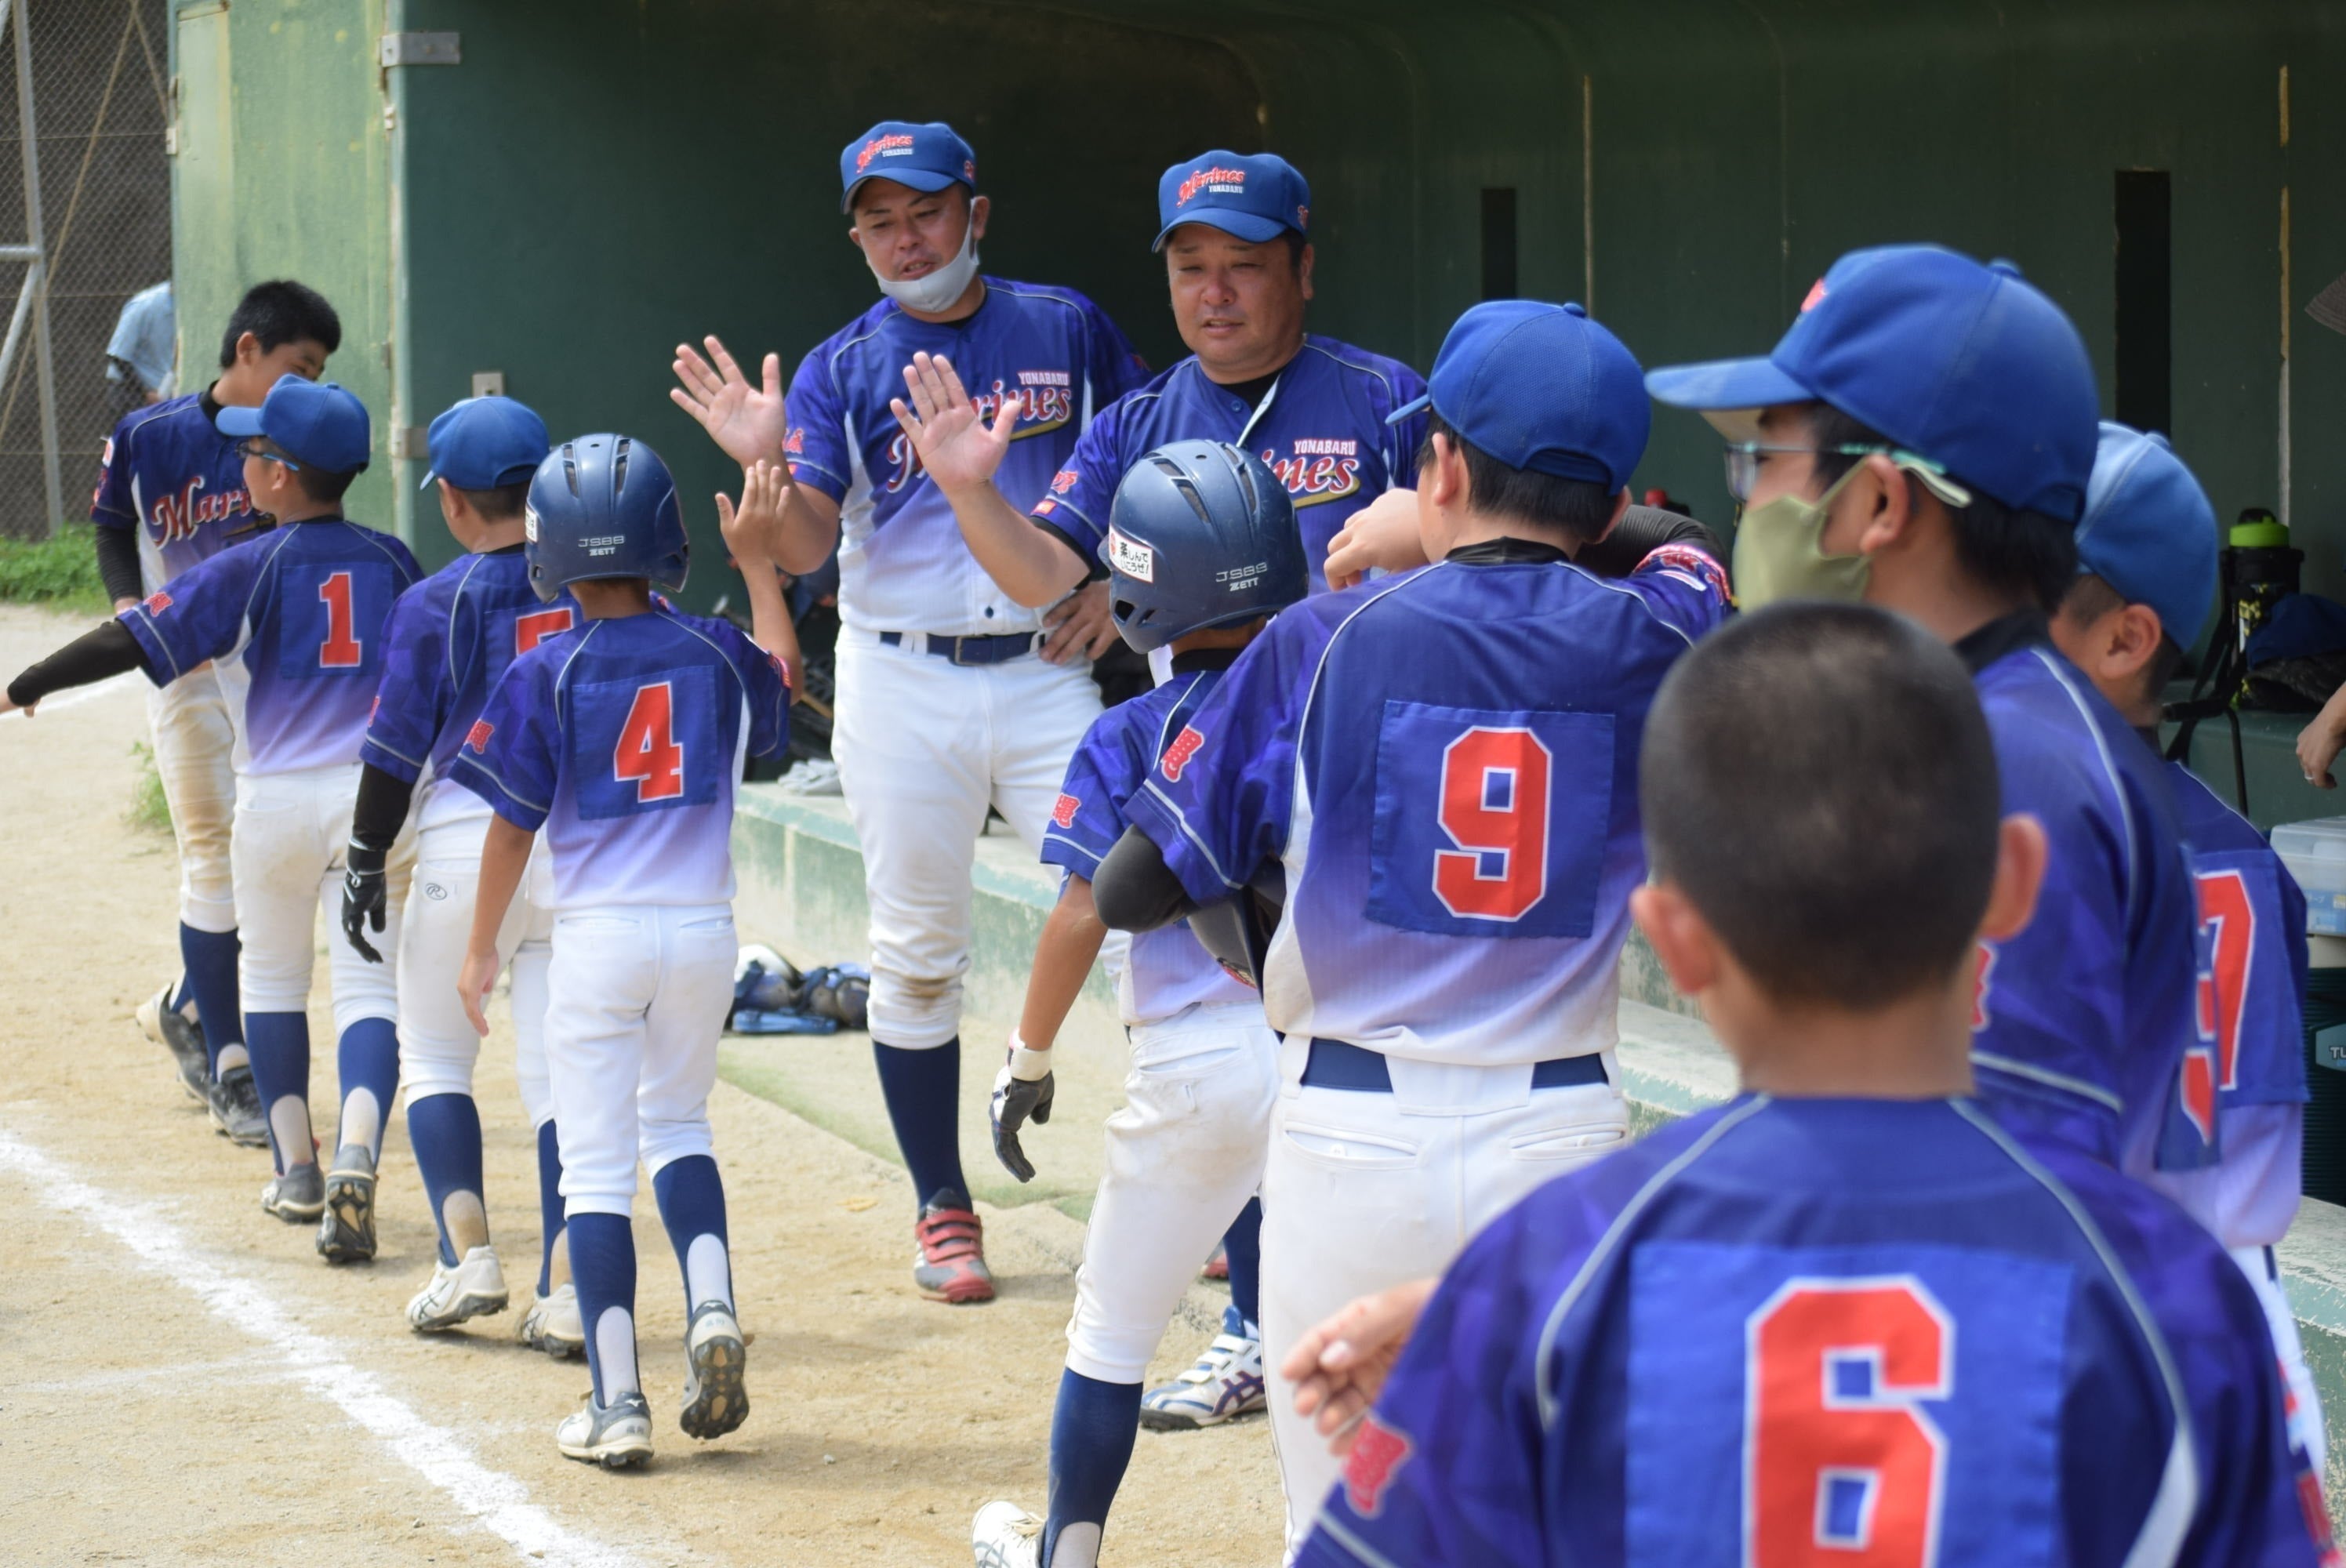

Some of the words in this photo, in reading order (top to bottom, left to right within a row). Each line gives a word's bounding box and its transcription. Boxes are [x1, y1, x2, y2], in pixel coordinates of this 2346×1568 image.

[1177, 167, 1245, 208] Marines
[1018, 372, 1069, 386] YONABARU
[1294, 439, 1356, 455] YONABARU
[151, 475, 252, 550] Mari
[589, 547, 616, 556] ZETT
[1229, 577, 1259, 591] ZETT
[319, 572, 361, 668] 1
[614, 681, 684, 803] 4
[1433, 726, 1553, 922] 9
[1744, 1275, 1955, 1568] 6
